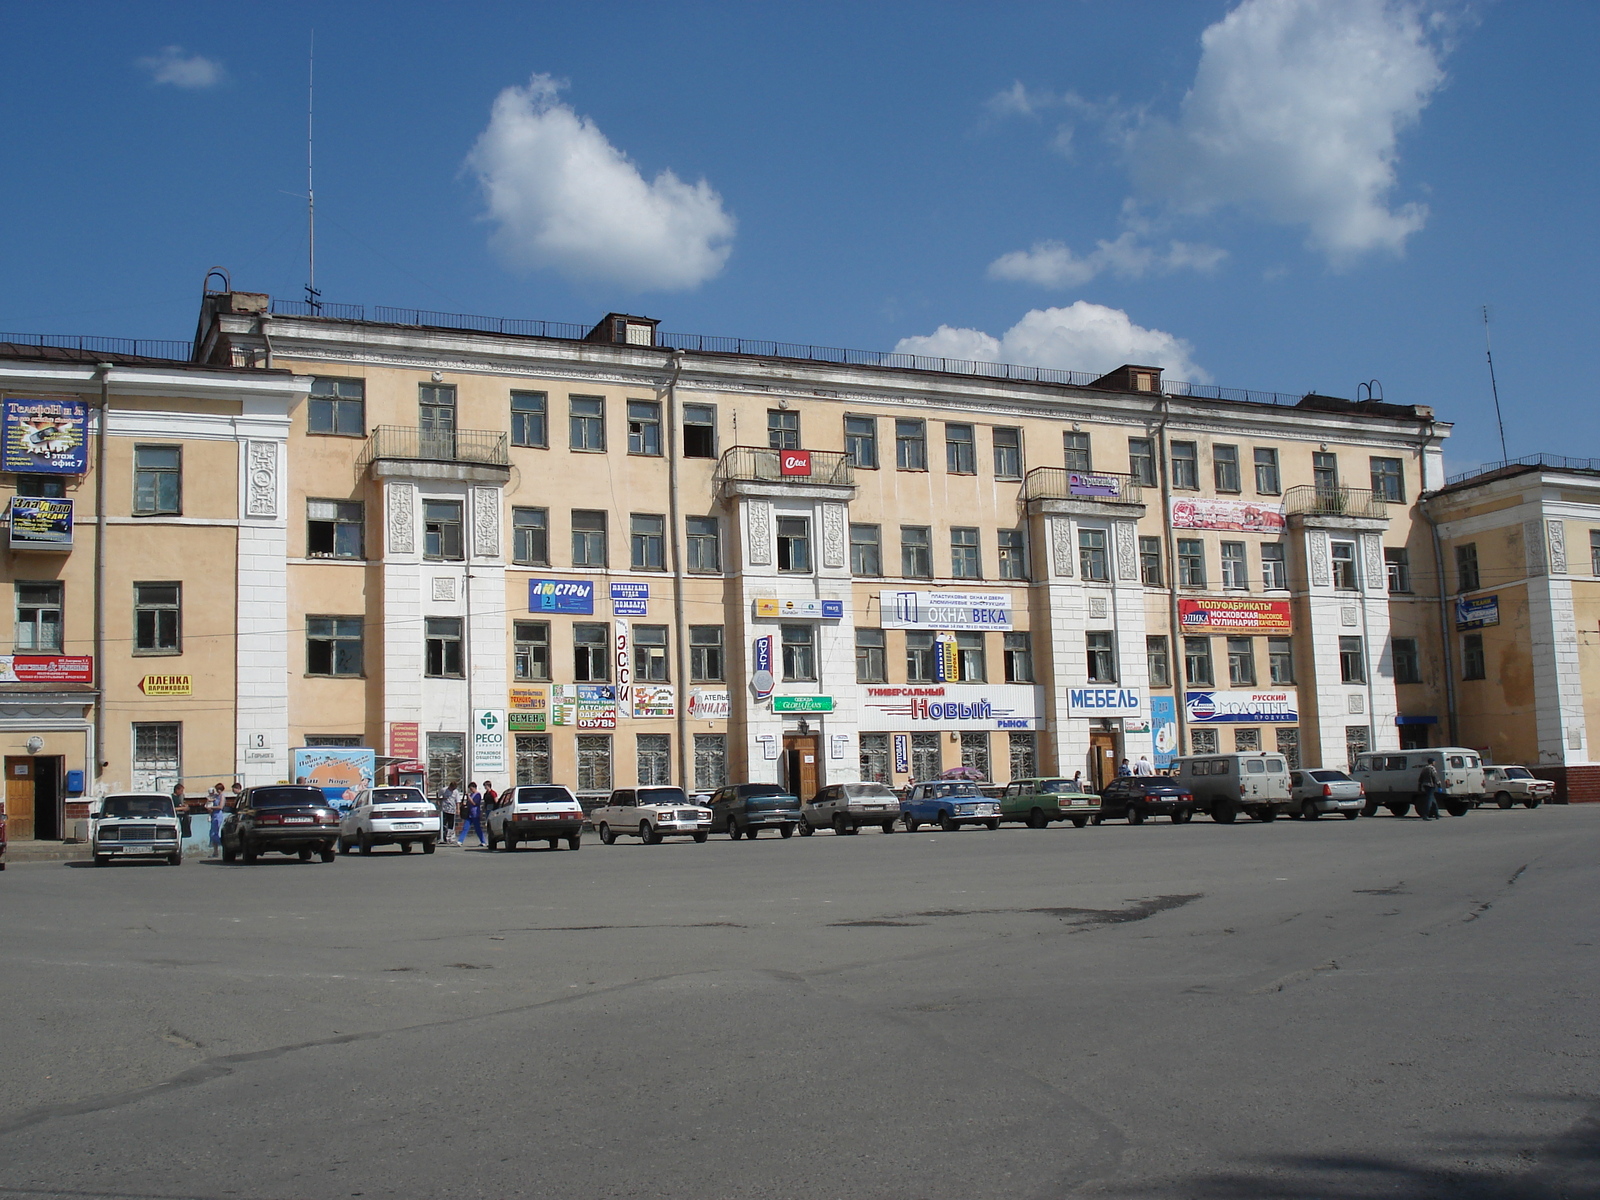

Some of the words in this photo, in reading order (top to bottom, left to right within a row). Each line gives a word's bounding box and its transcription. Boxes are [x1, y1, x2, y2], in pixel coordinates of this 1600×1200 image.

[52, 460, 75, 468] офис
[533, 583, 590, 597] ЛЮСТРЫ
[615, 601, 645, 609] ЛОМБАРД
[1198, 601, 1272, 610] ПОЛУФАБРИКАТЫ
[928, 608, 967, 623] ОКНА
[972, 609, 1006, 623] ВЕКА
[1183, 614, 1209, 622] ЭЛИКА
[759, 640, 768, 670] ЮУСТ
[149, 676, 189, 684] ПЛЕНКА
[868, 687, 945, 696] УНИВЕРСАЛЬНЫЙ
[1071, 690, 1138, 708] МЕБЕЛЬ
[1252, 693, 1286, 701] РУССКИЙ
[1220, 702, 1288, 714] МОЛОЧНЫЙ
[257, 734, 264, 747] 3
[476, 734, 502, 743] РЕСО
